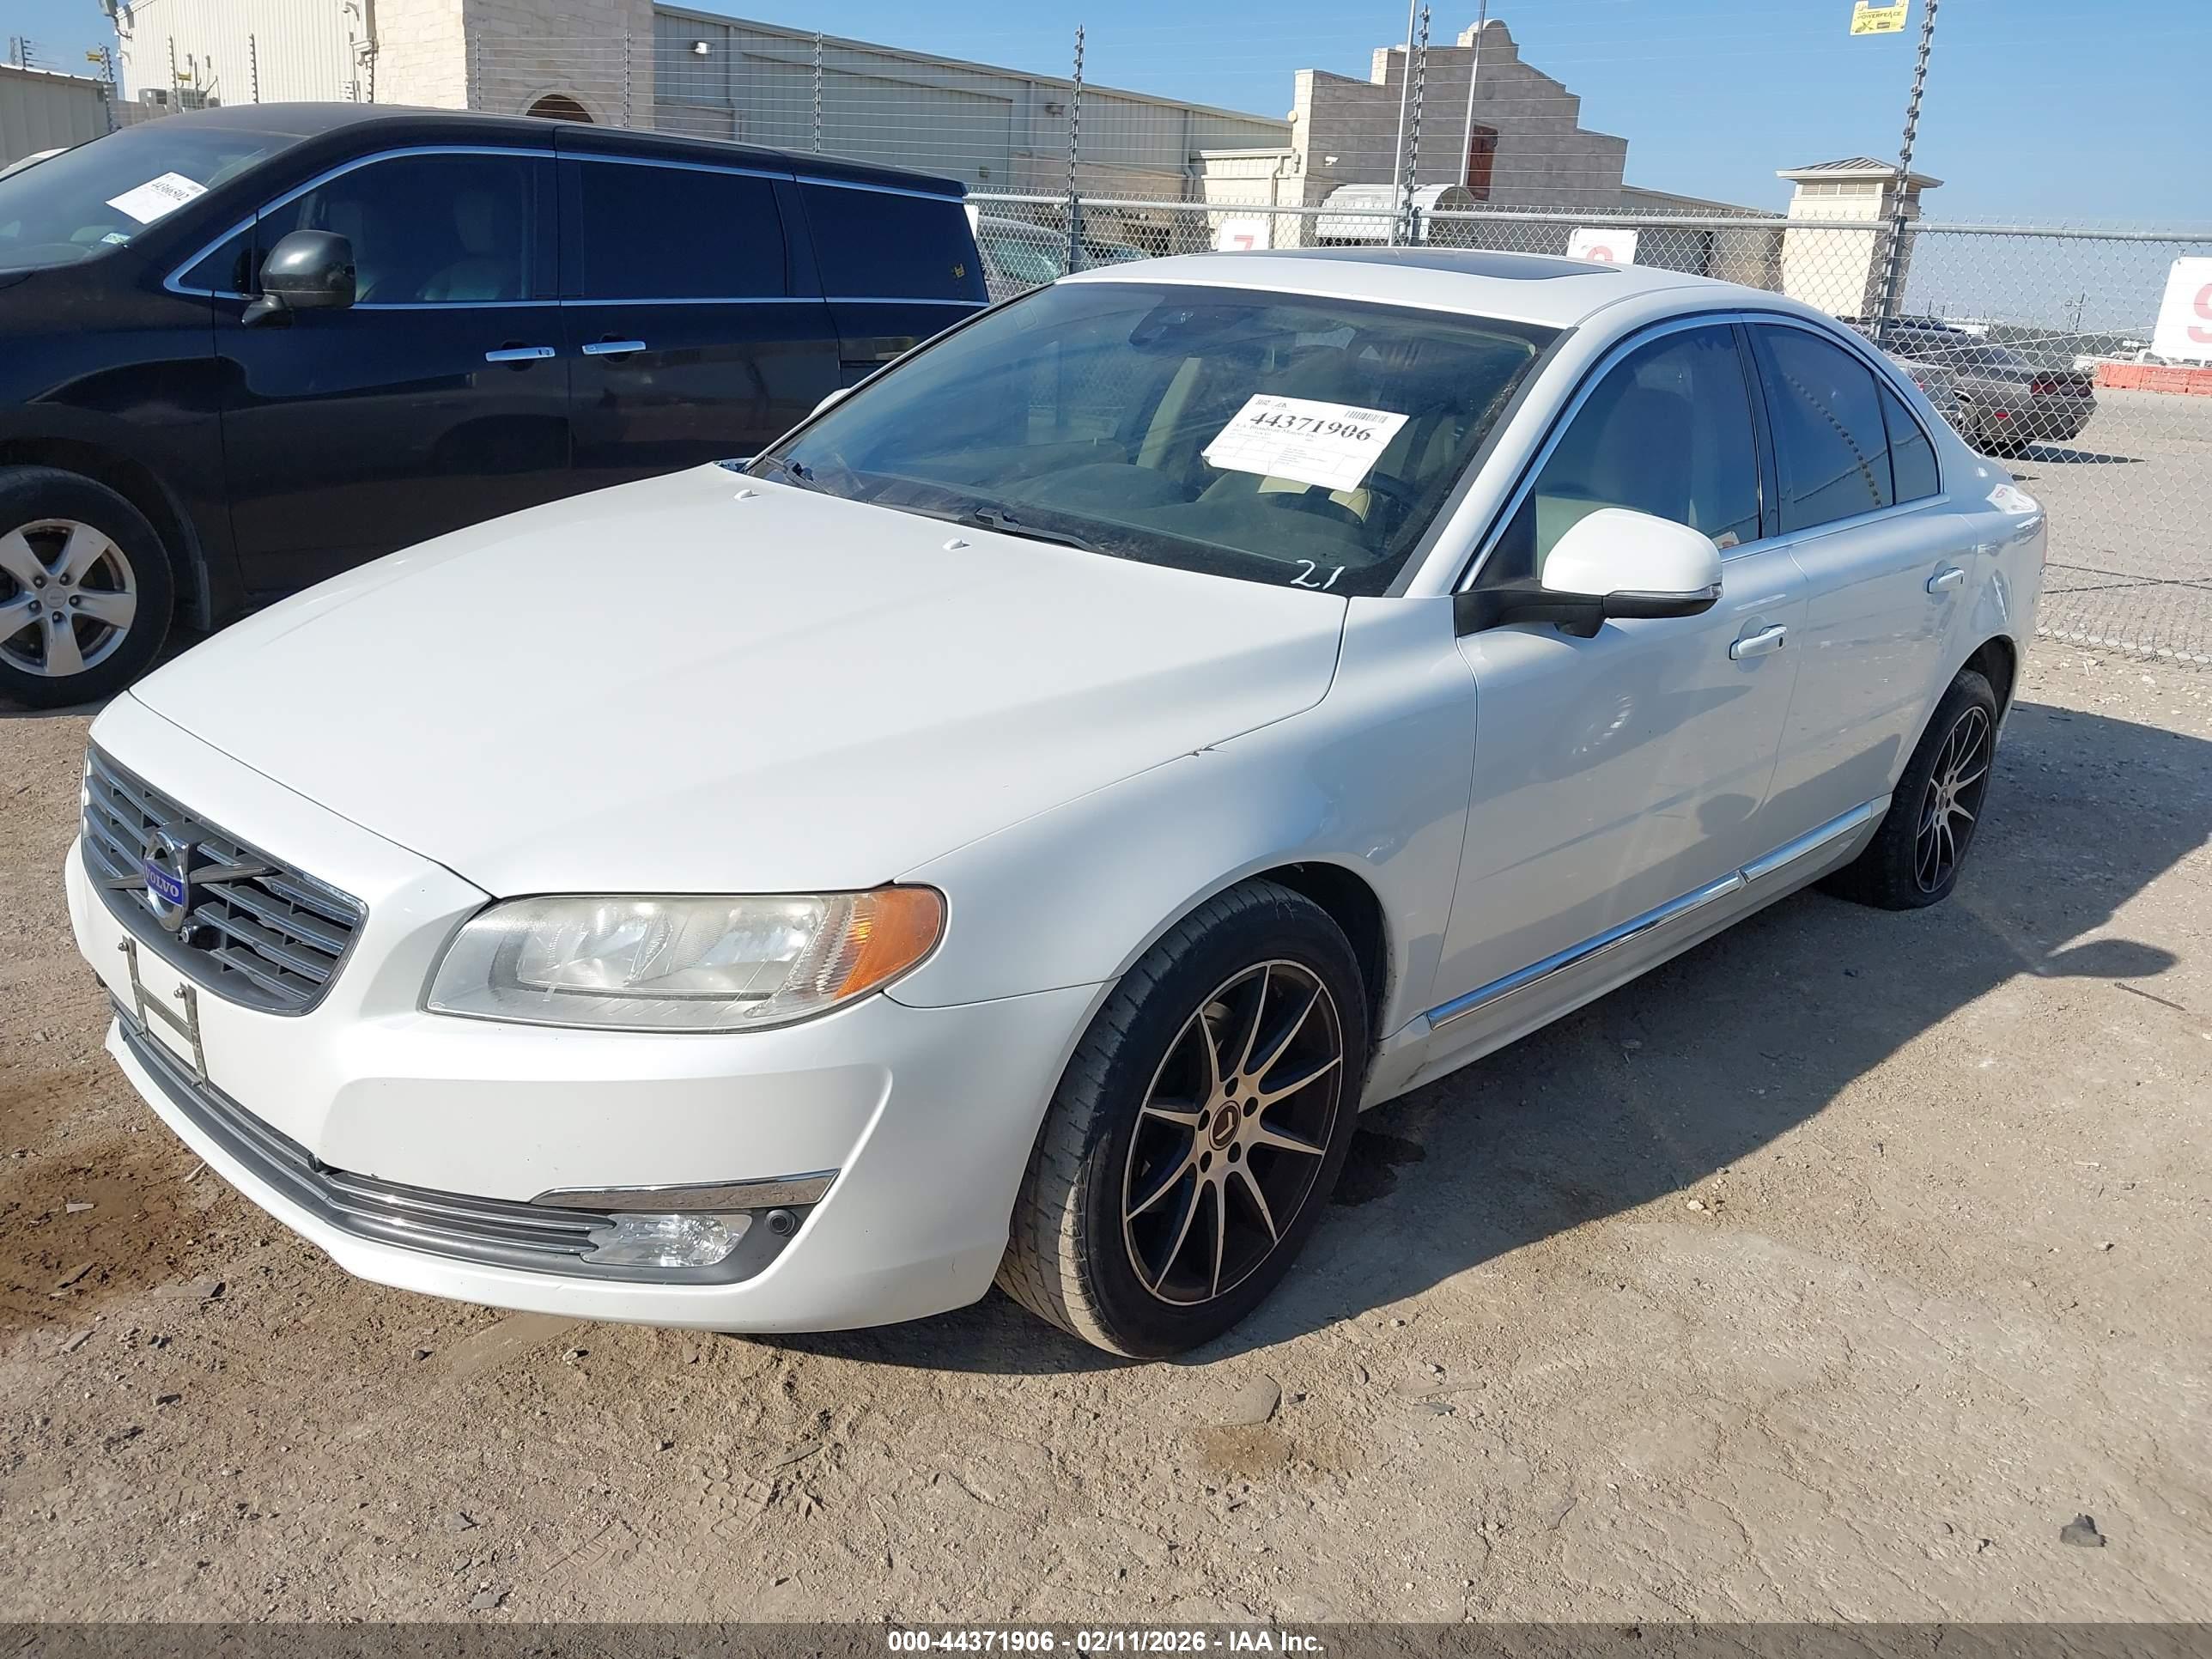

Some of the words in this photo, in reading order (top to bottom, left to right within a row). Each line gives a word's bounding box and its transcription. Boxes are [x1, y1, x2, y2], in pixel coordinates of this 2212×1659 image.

[1234, 234, 1255, 252] 7
[1250, 411, 1376, 441] 44371906
[1291, 559, 1346, 590] 21
[146, 868, 179, 897] VOLVO
